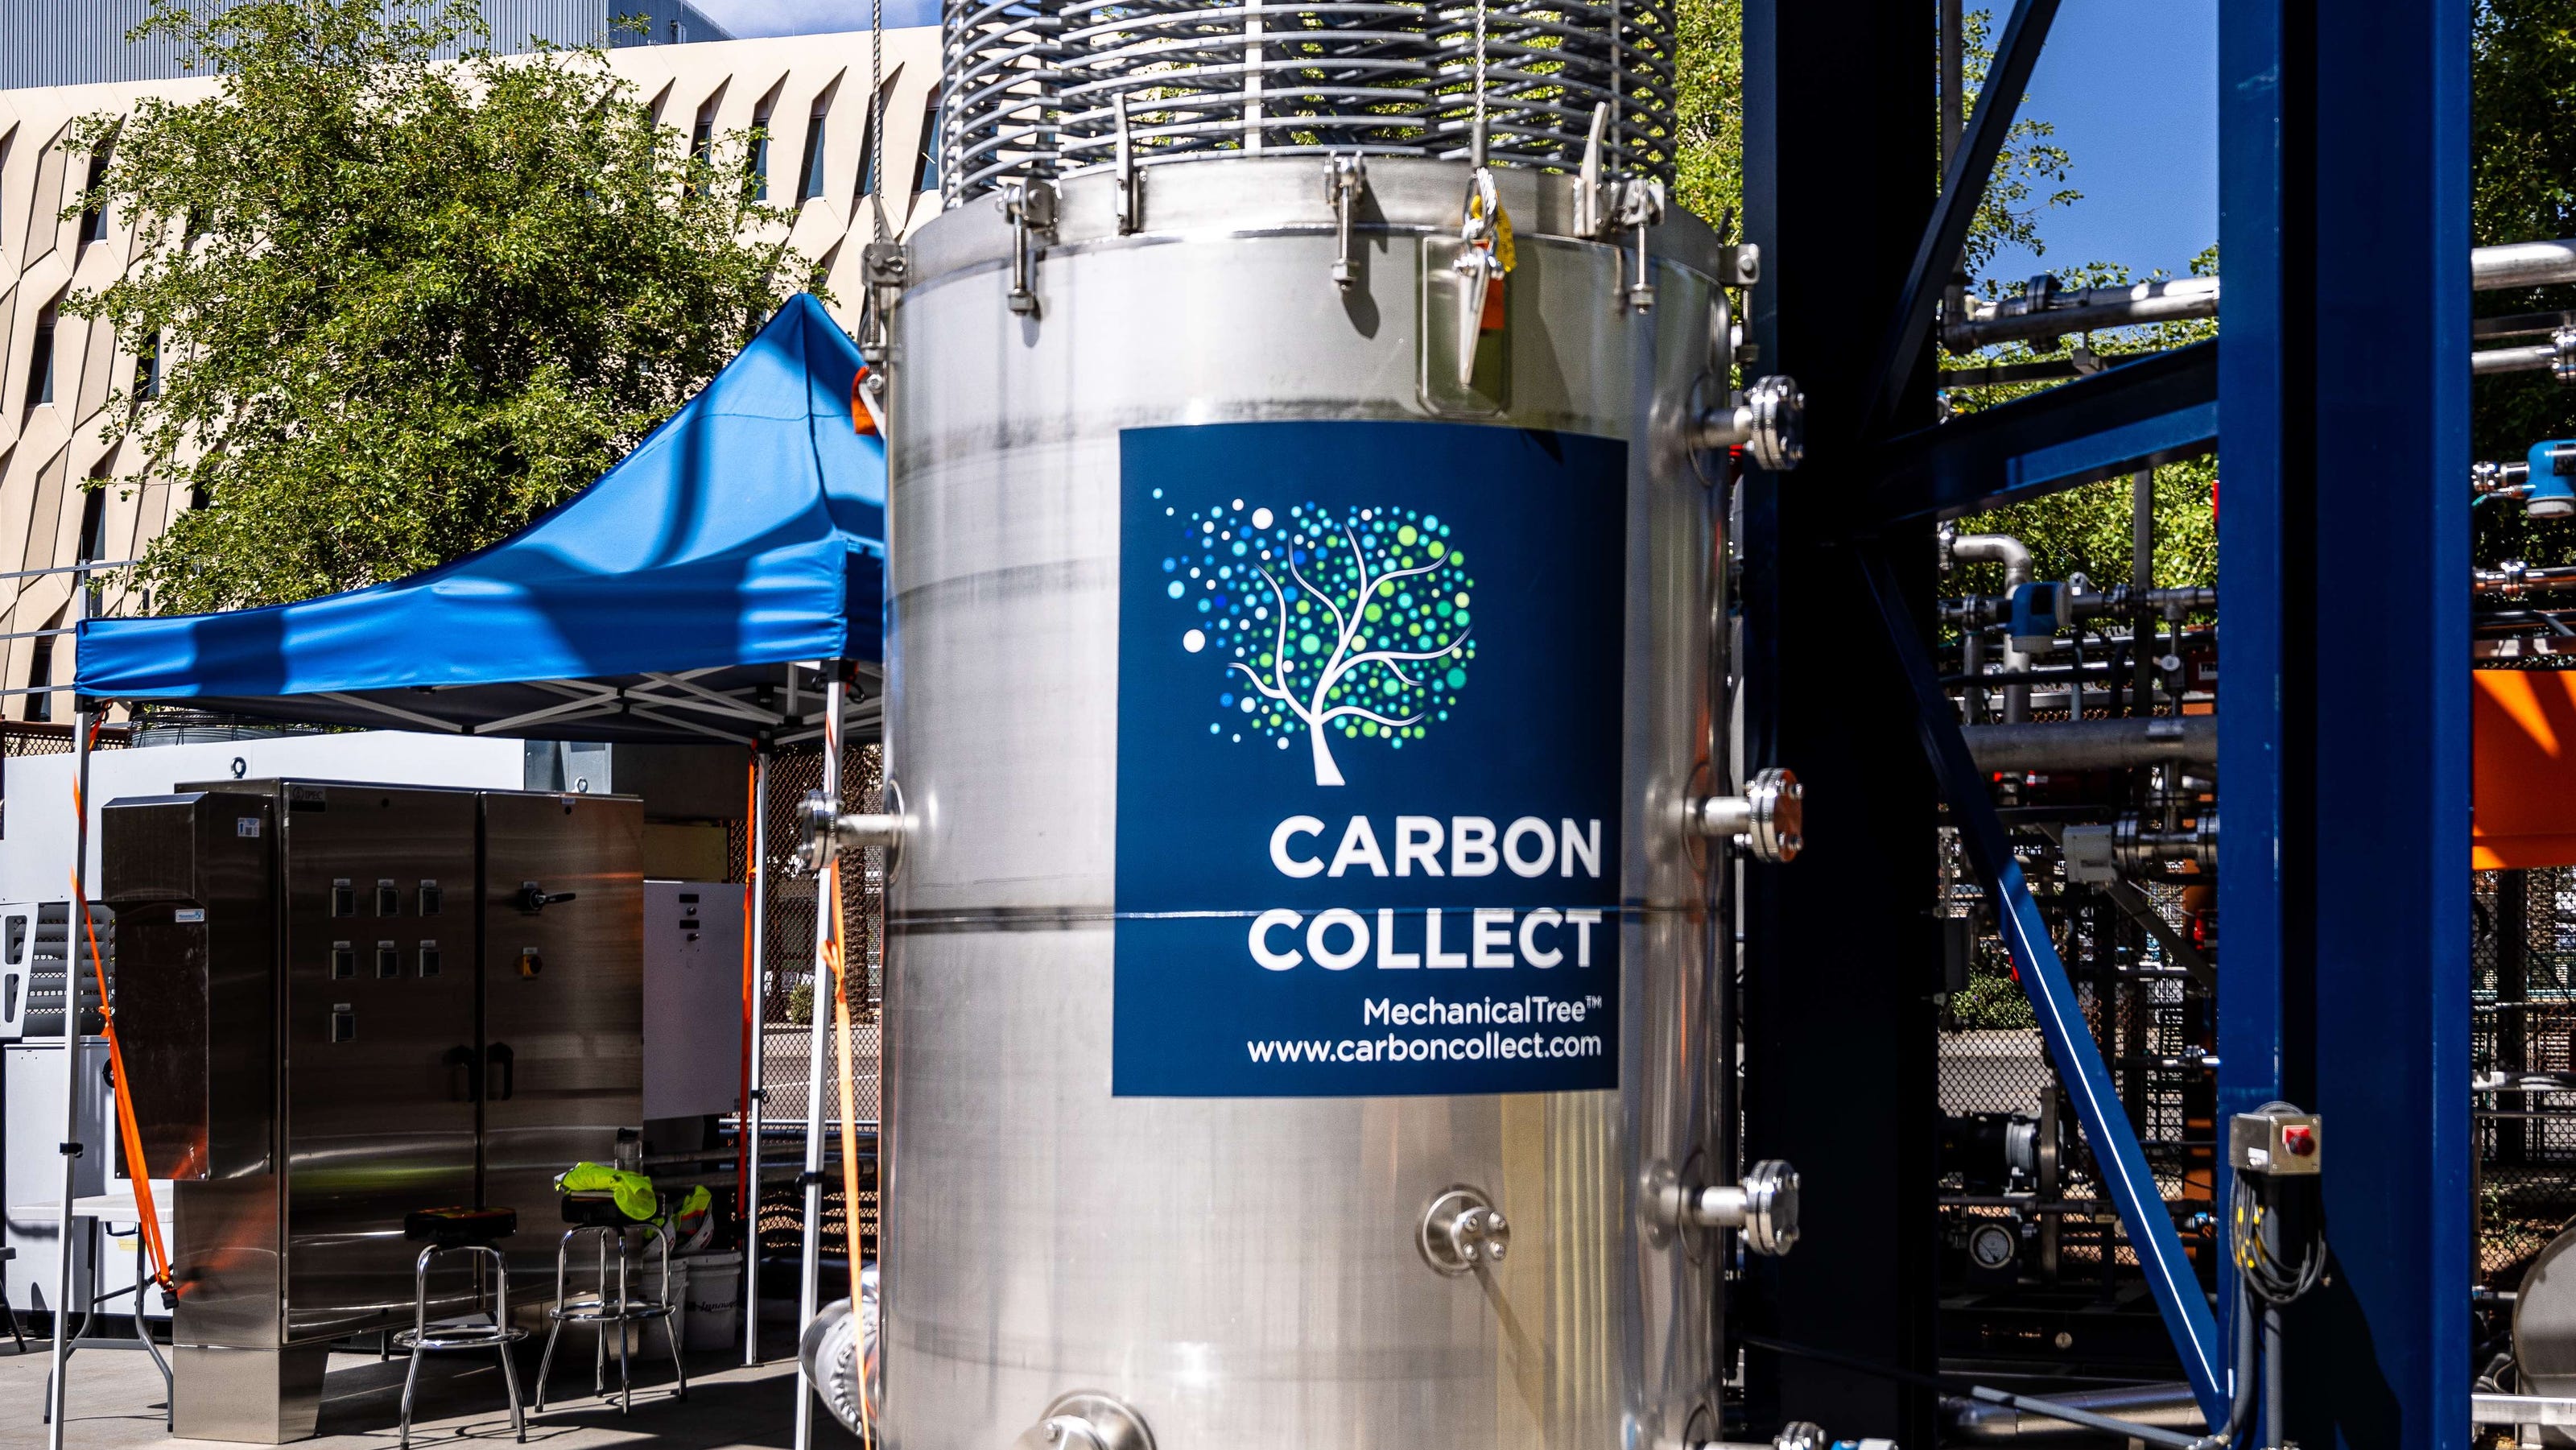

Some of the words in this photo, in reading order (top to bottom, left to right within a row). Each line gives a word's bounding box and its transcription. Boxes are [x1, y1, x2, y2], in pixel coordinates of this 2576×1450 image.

[1269, 815, 1601, 878] CARBON
[1248, 907, 1602, 971] COLLECT
[1247, 1031, 1602, 1063] www.carboncollect.com
